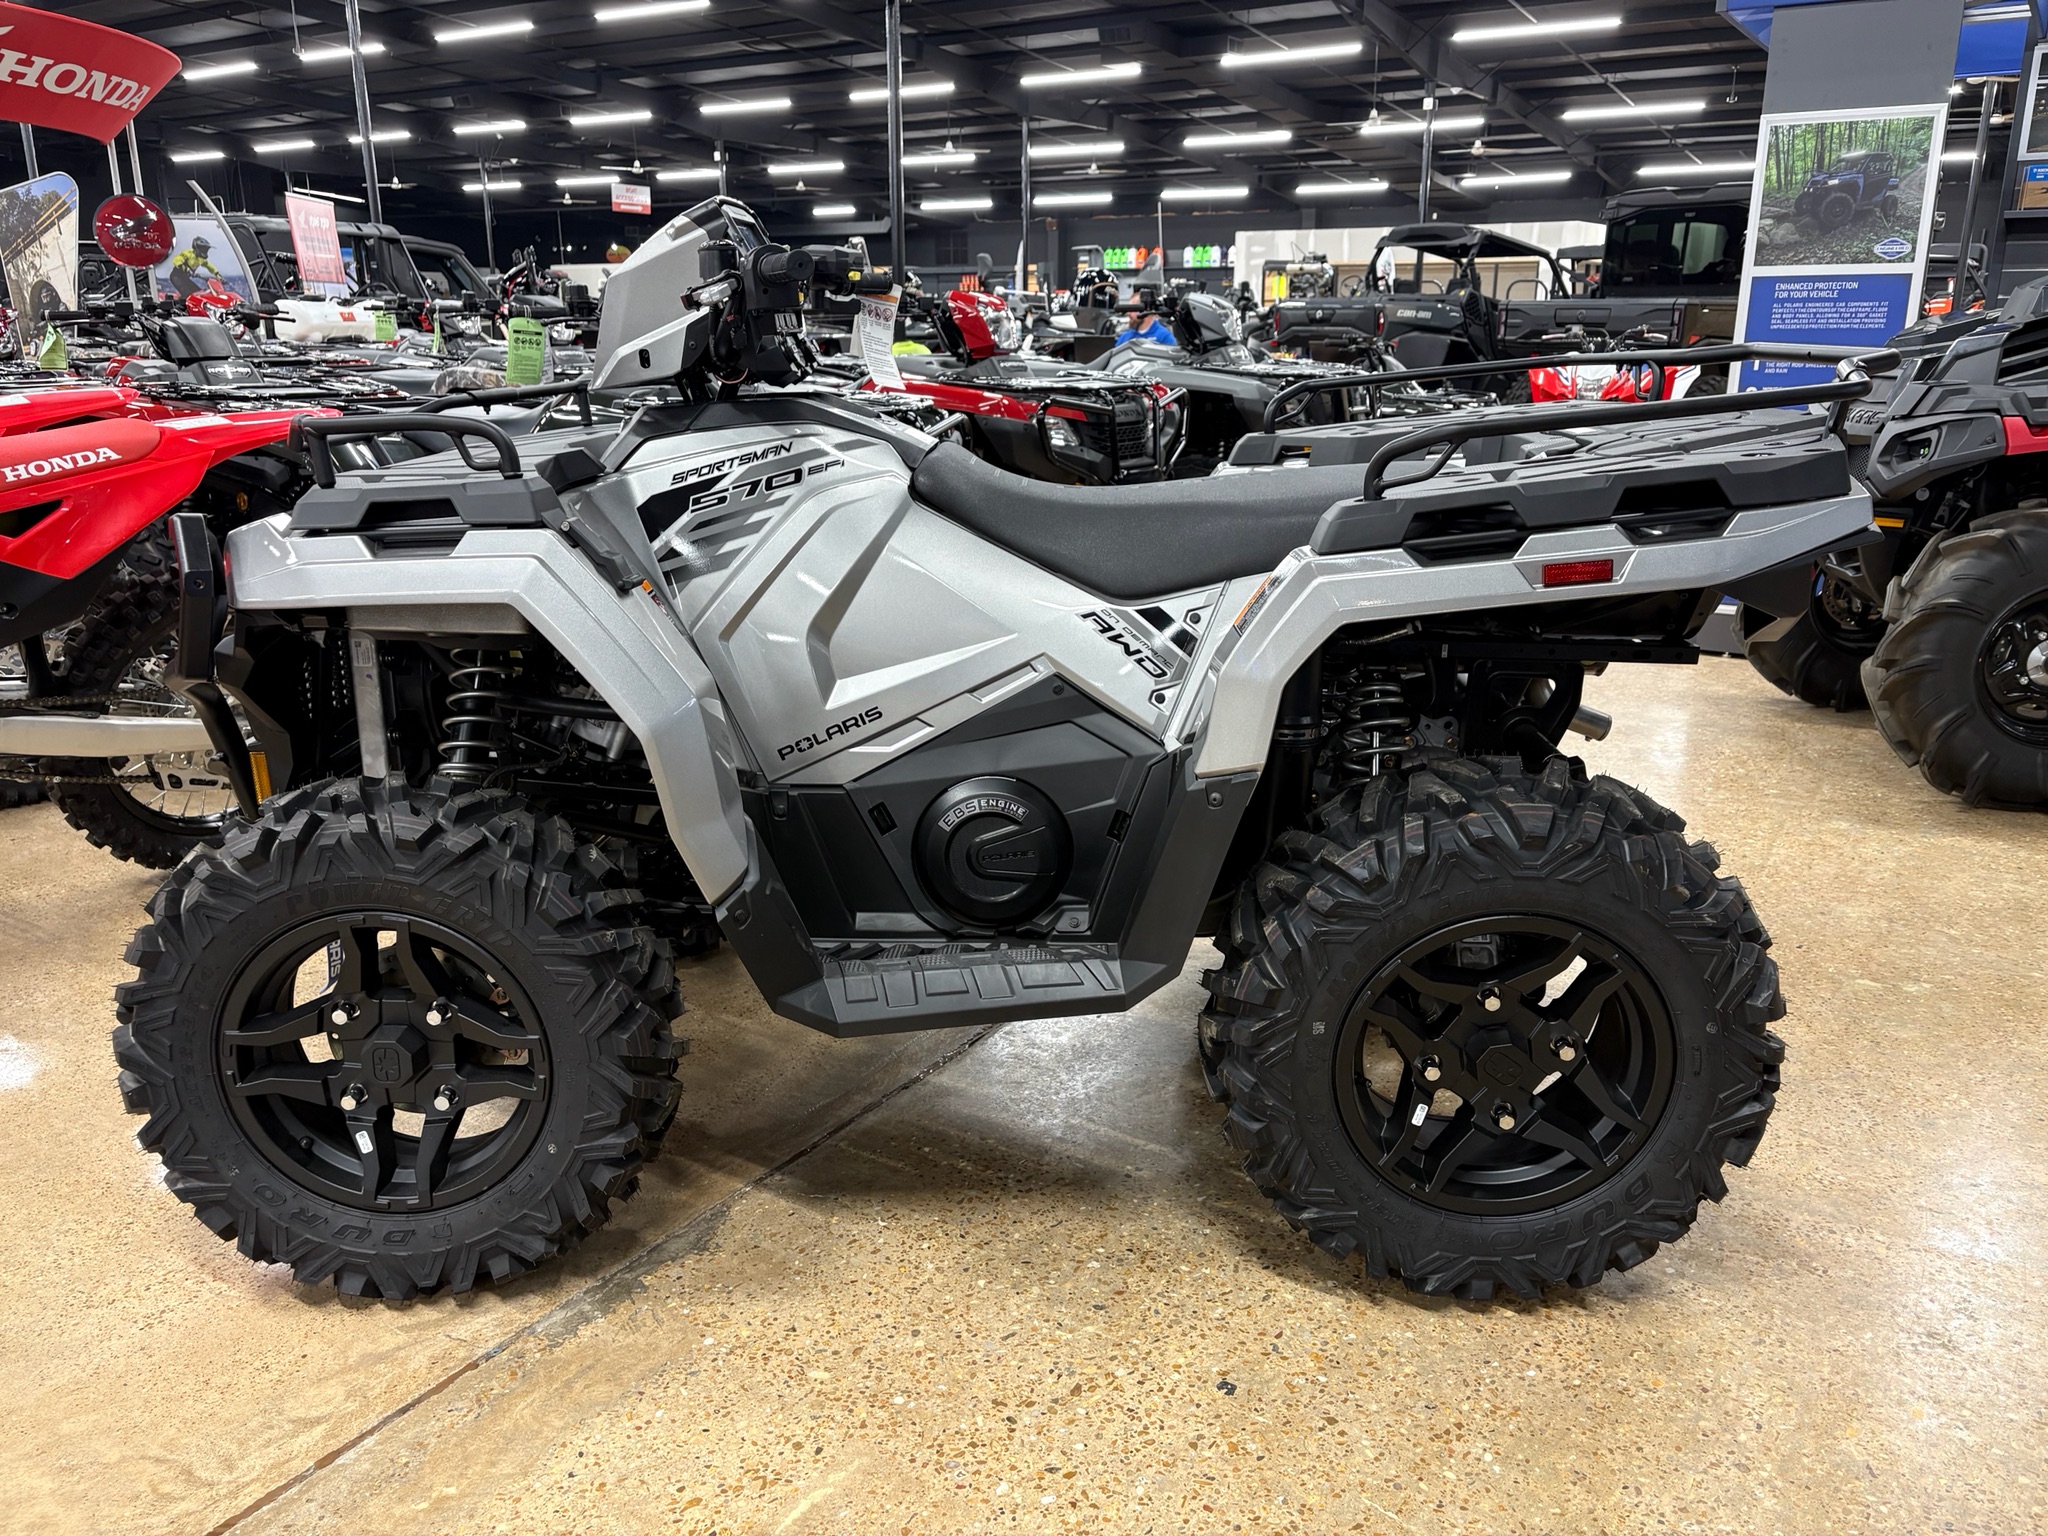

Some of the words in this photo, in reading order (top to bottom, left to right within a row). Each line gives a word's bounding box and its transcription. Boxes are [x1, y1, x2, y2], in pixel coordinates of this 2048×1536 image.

[0, 48, 151, 112] HONDA
[1774, 290, 1788, 299] FOR
[1789, 290, 1809, 298] YOUR
[1809, 289, 1839, 298] VEHICLE
[1775, 282, 1813, 291] ENHANCED
[1814, 281, 1859, 290] PROTECTION
[1396, 308, 1432, 320] can-am
[1116, 408, 1142, 418] ONDA
[1846, 407, 1885, 425] ARIS
[0, 446, 122, 483] HONDA
[670, 441, 794, 487] SPORTSMAN
[688, 467, 804, 515] 570
[806, 458, 846, 478] EFI
[1079, 611, 1169, 679] AWD
[1122, 626, 1175, 670] DEMAND
[776, 706, 884, 762] POLARIS
[942, 801, 978, 828] EBS
[980, 799, 1027, 816] ENGINE
[981, 850, 1036, 863] POLARIS
[425, 896, 514, 947] GRIP
[328, 938, 342, 978] ARIS
[253, 1182, 416, 1247] DURO
[1487, 1168, 1653, 1251] DURO
